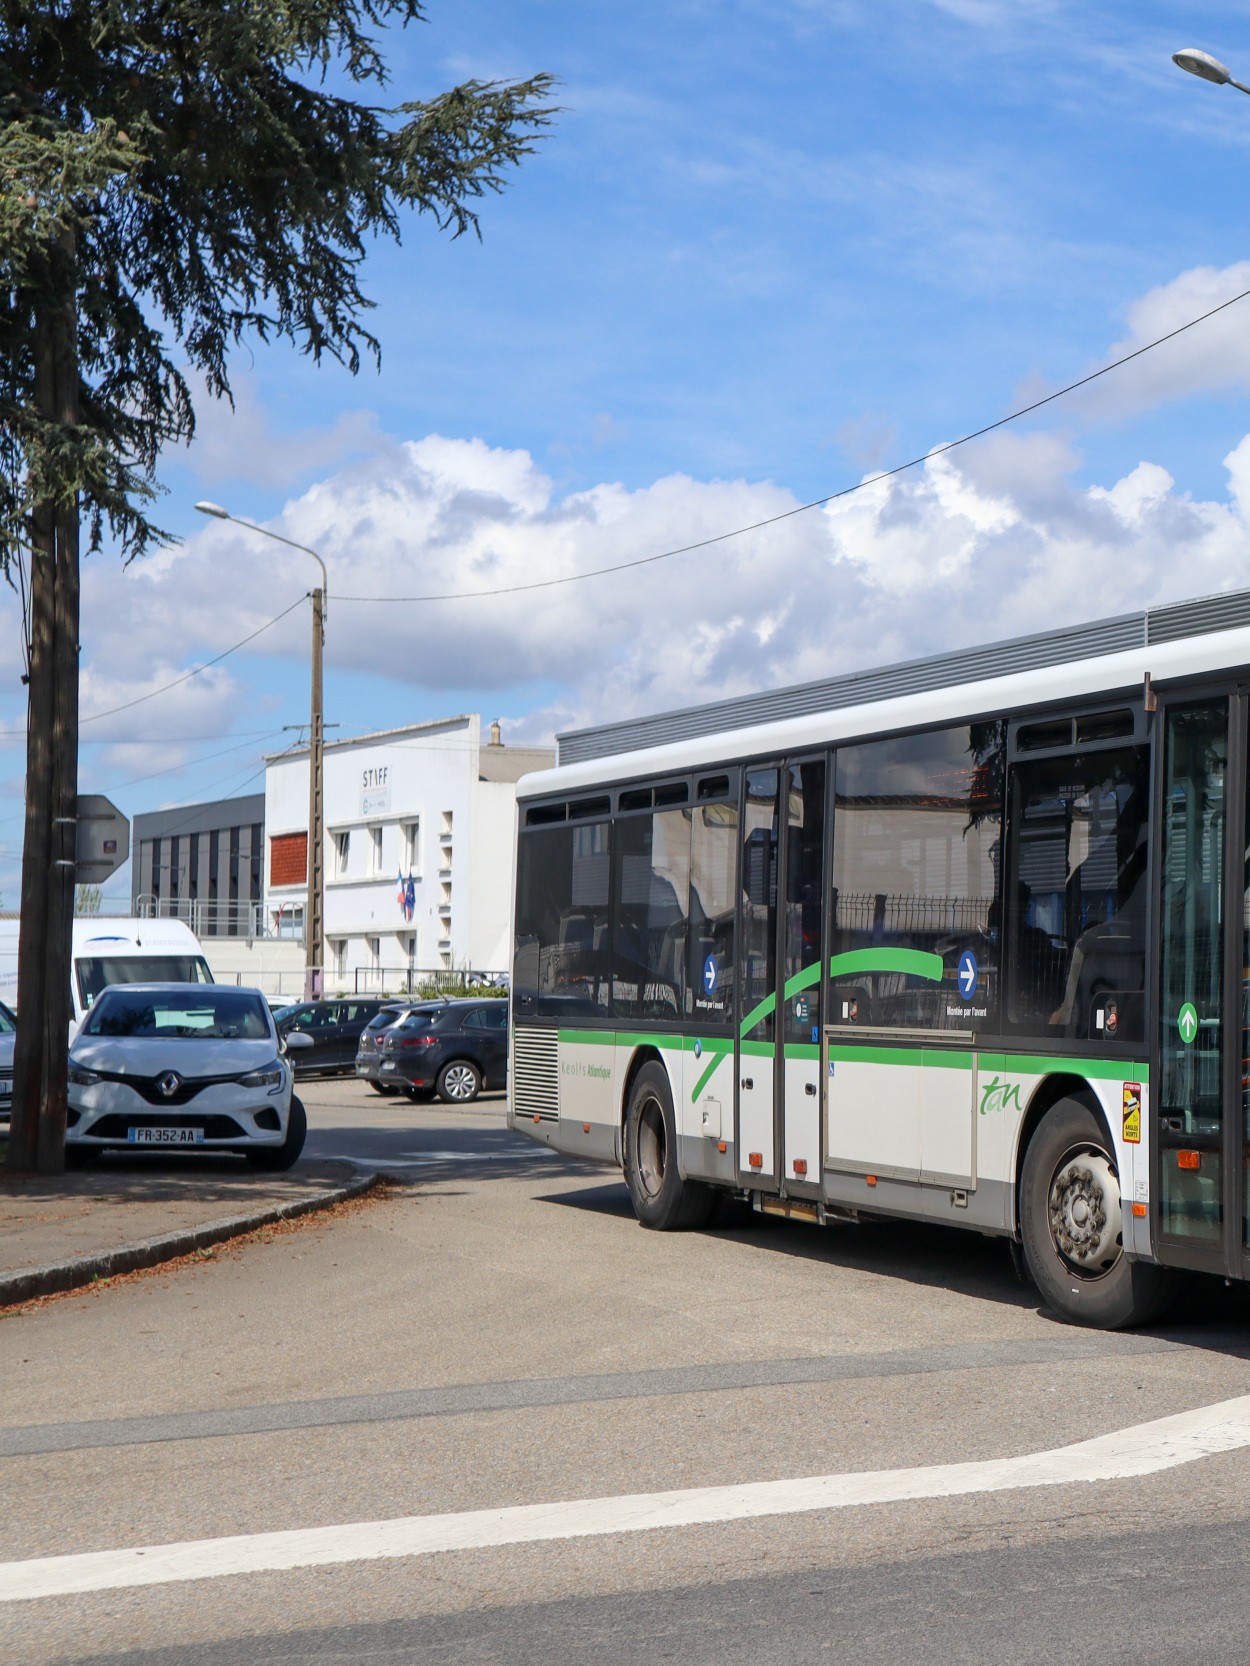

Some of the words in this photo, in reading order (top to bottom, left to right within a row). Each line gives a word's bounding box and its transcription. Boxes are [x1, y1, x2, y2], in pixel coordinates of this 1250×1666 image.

[946, 1006, 963, 1016] Montée
[964, 1008, 972, 1018] par
[980, 1076, 1022, 1115] tan
[137, 1130, 194, 1142] FR-352-AA
